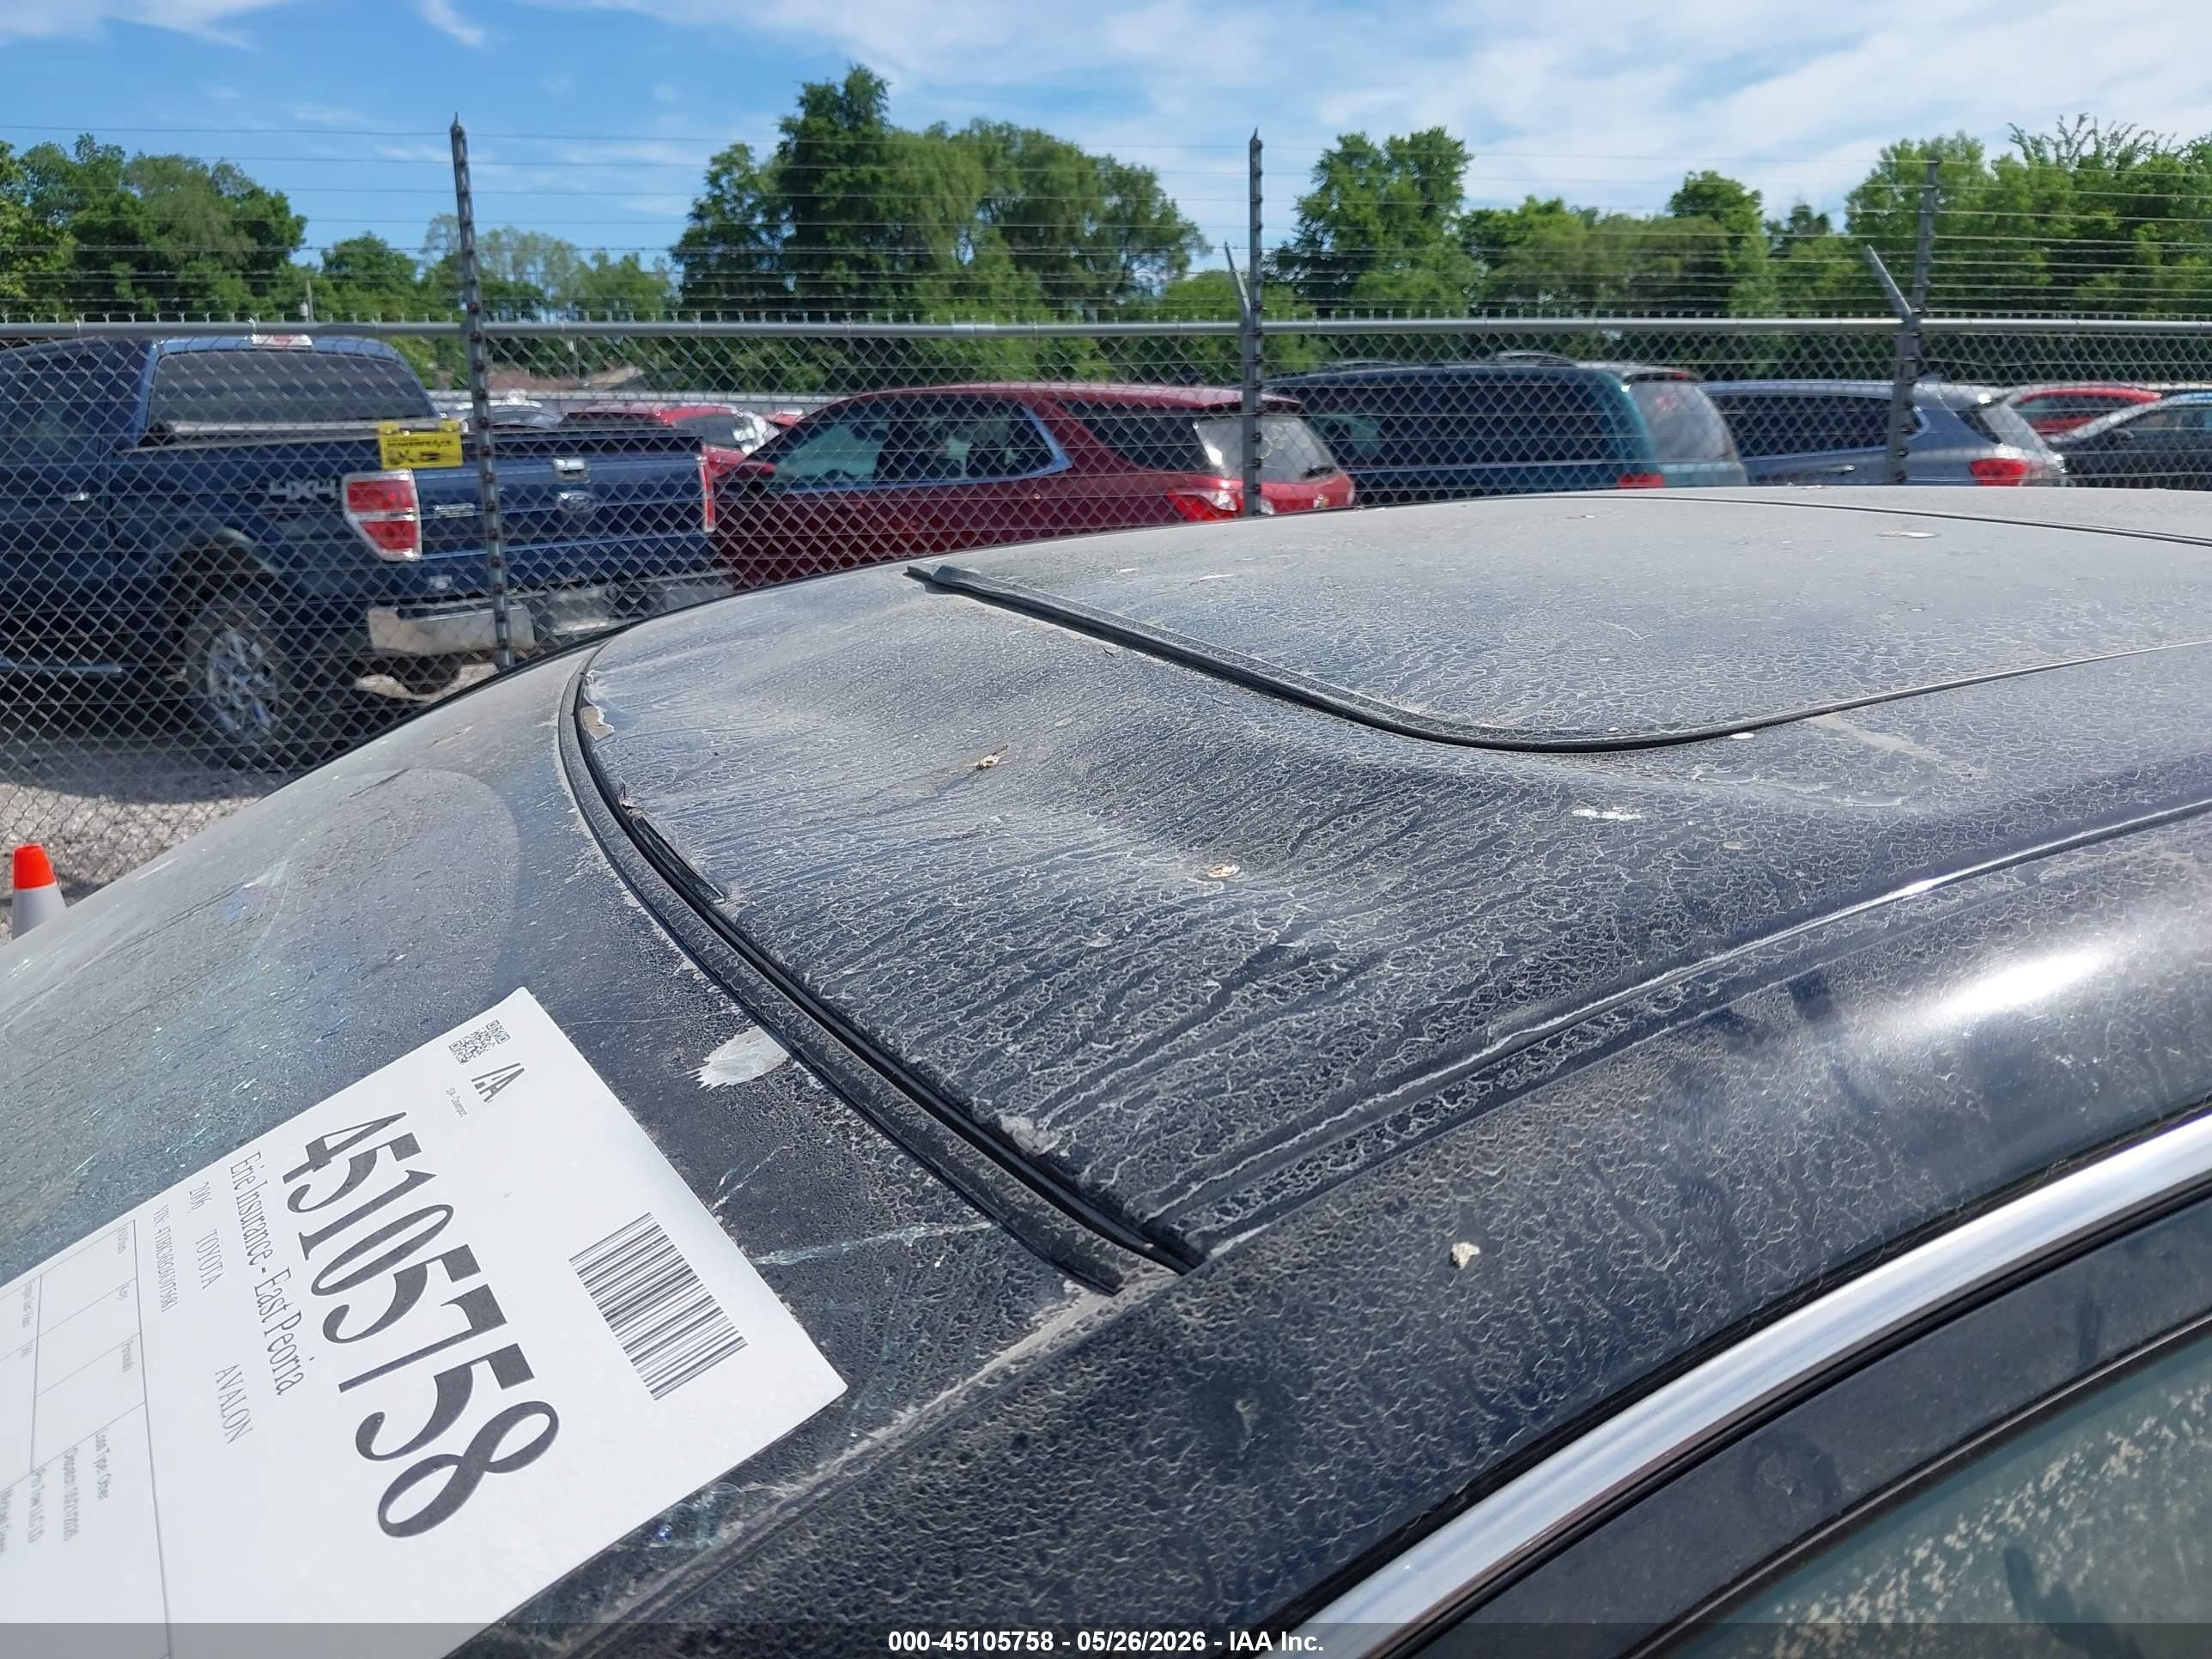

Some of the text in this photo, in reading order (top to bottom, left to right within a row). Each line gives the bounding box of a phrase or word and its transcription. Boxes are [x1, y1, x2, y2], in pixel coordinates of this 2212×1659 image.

[230, 1151, 264, 1190] Erie
[236, 1180, 273, 1266] Insurance
[190, 1182, 252, 1443] 2006 TOYOTA AVALON
[254, 1267, 293, 1323] East
[283, 1112, 559, 1538] 45105758
[264, 1310, 314, 1395] Peoria
